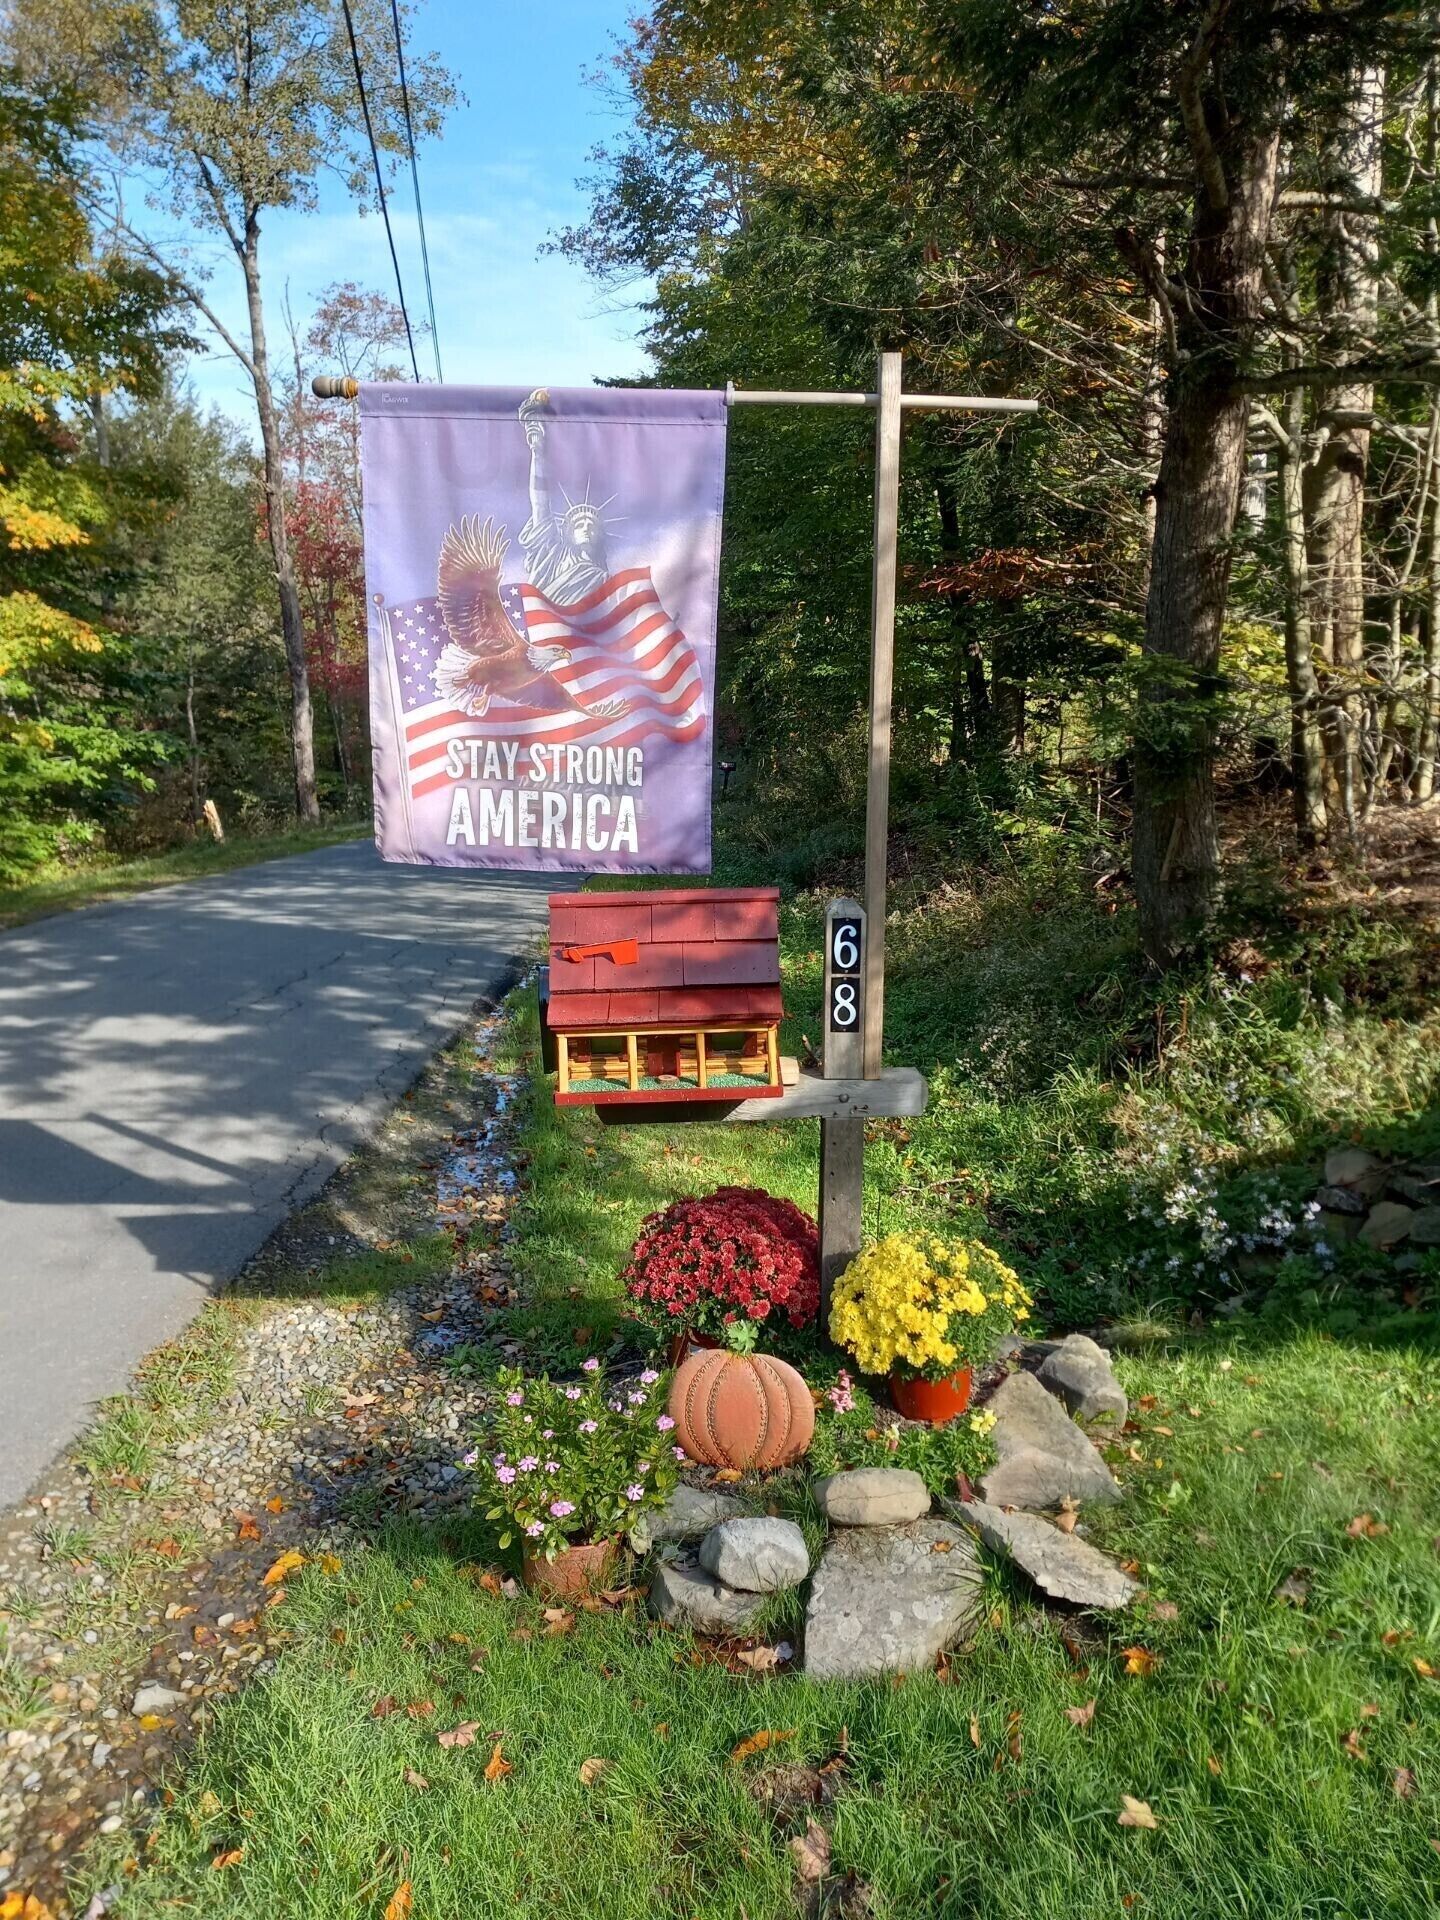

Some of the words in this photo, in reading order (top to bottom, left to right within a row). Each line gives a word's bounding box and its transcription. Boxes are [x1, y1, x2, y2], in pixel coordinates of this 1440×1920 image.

[445, 738, 520, 781] STAY
[528, 742, 644, 787] STRONG
[446, 787, 639, 853] AMERICA
